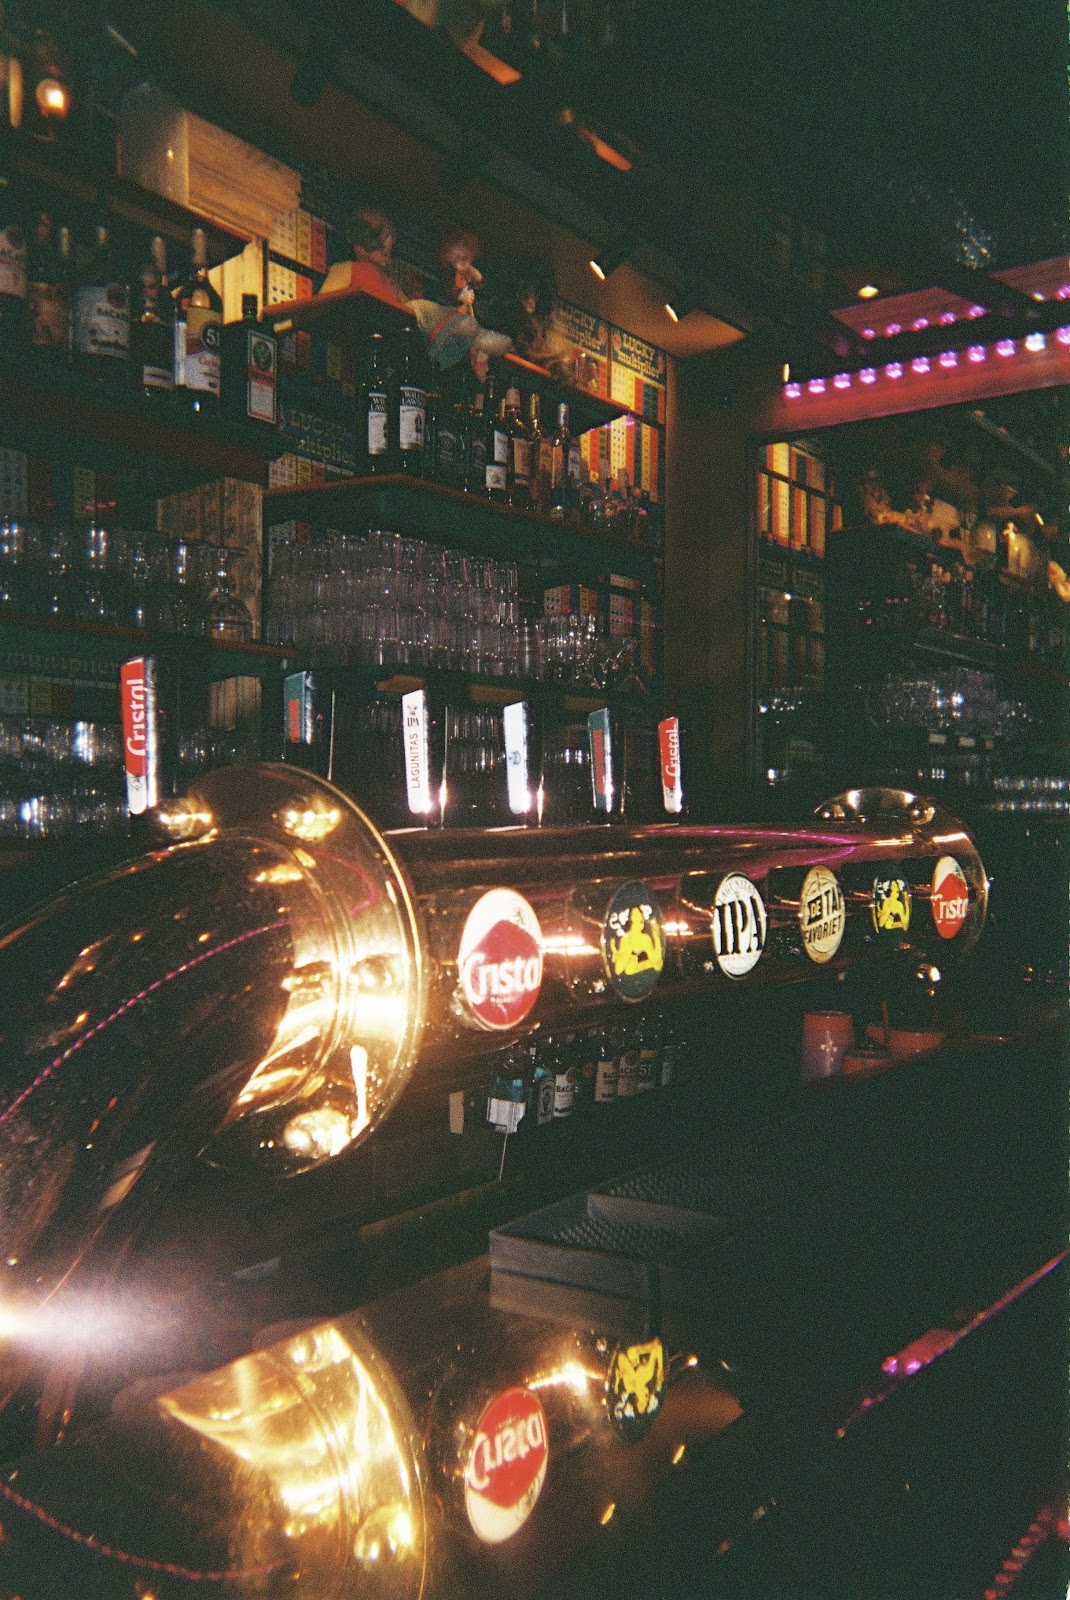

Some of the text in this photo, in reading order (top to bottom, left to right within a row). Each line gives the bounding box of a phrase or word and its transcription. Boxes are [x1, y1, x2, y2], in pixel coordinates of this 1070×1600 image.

[623, 333, 656, 361] LUCKY
[617, 349, 660, 379] multiplier
[288, 408, 347, 442] LUCKY
[126, 677, 147, 757] Cristal
[407, 716, 420, 728] IPA
[409, 732, 421, 789] LAGUNITAS
[665, 723, 679, 777] Cristal
[718, 879, 756, 905] LAGUNITAS
[810, 899, 822, 919] DE
[714, 896, 764, 955] IPA
[804, 915, 842, 945] FAVORIET
